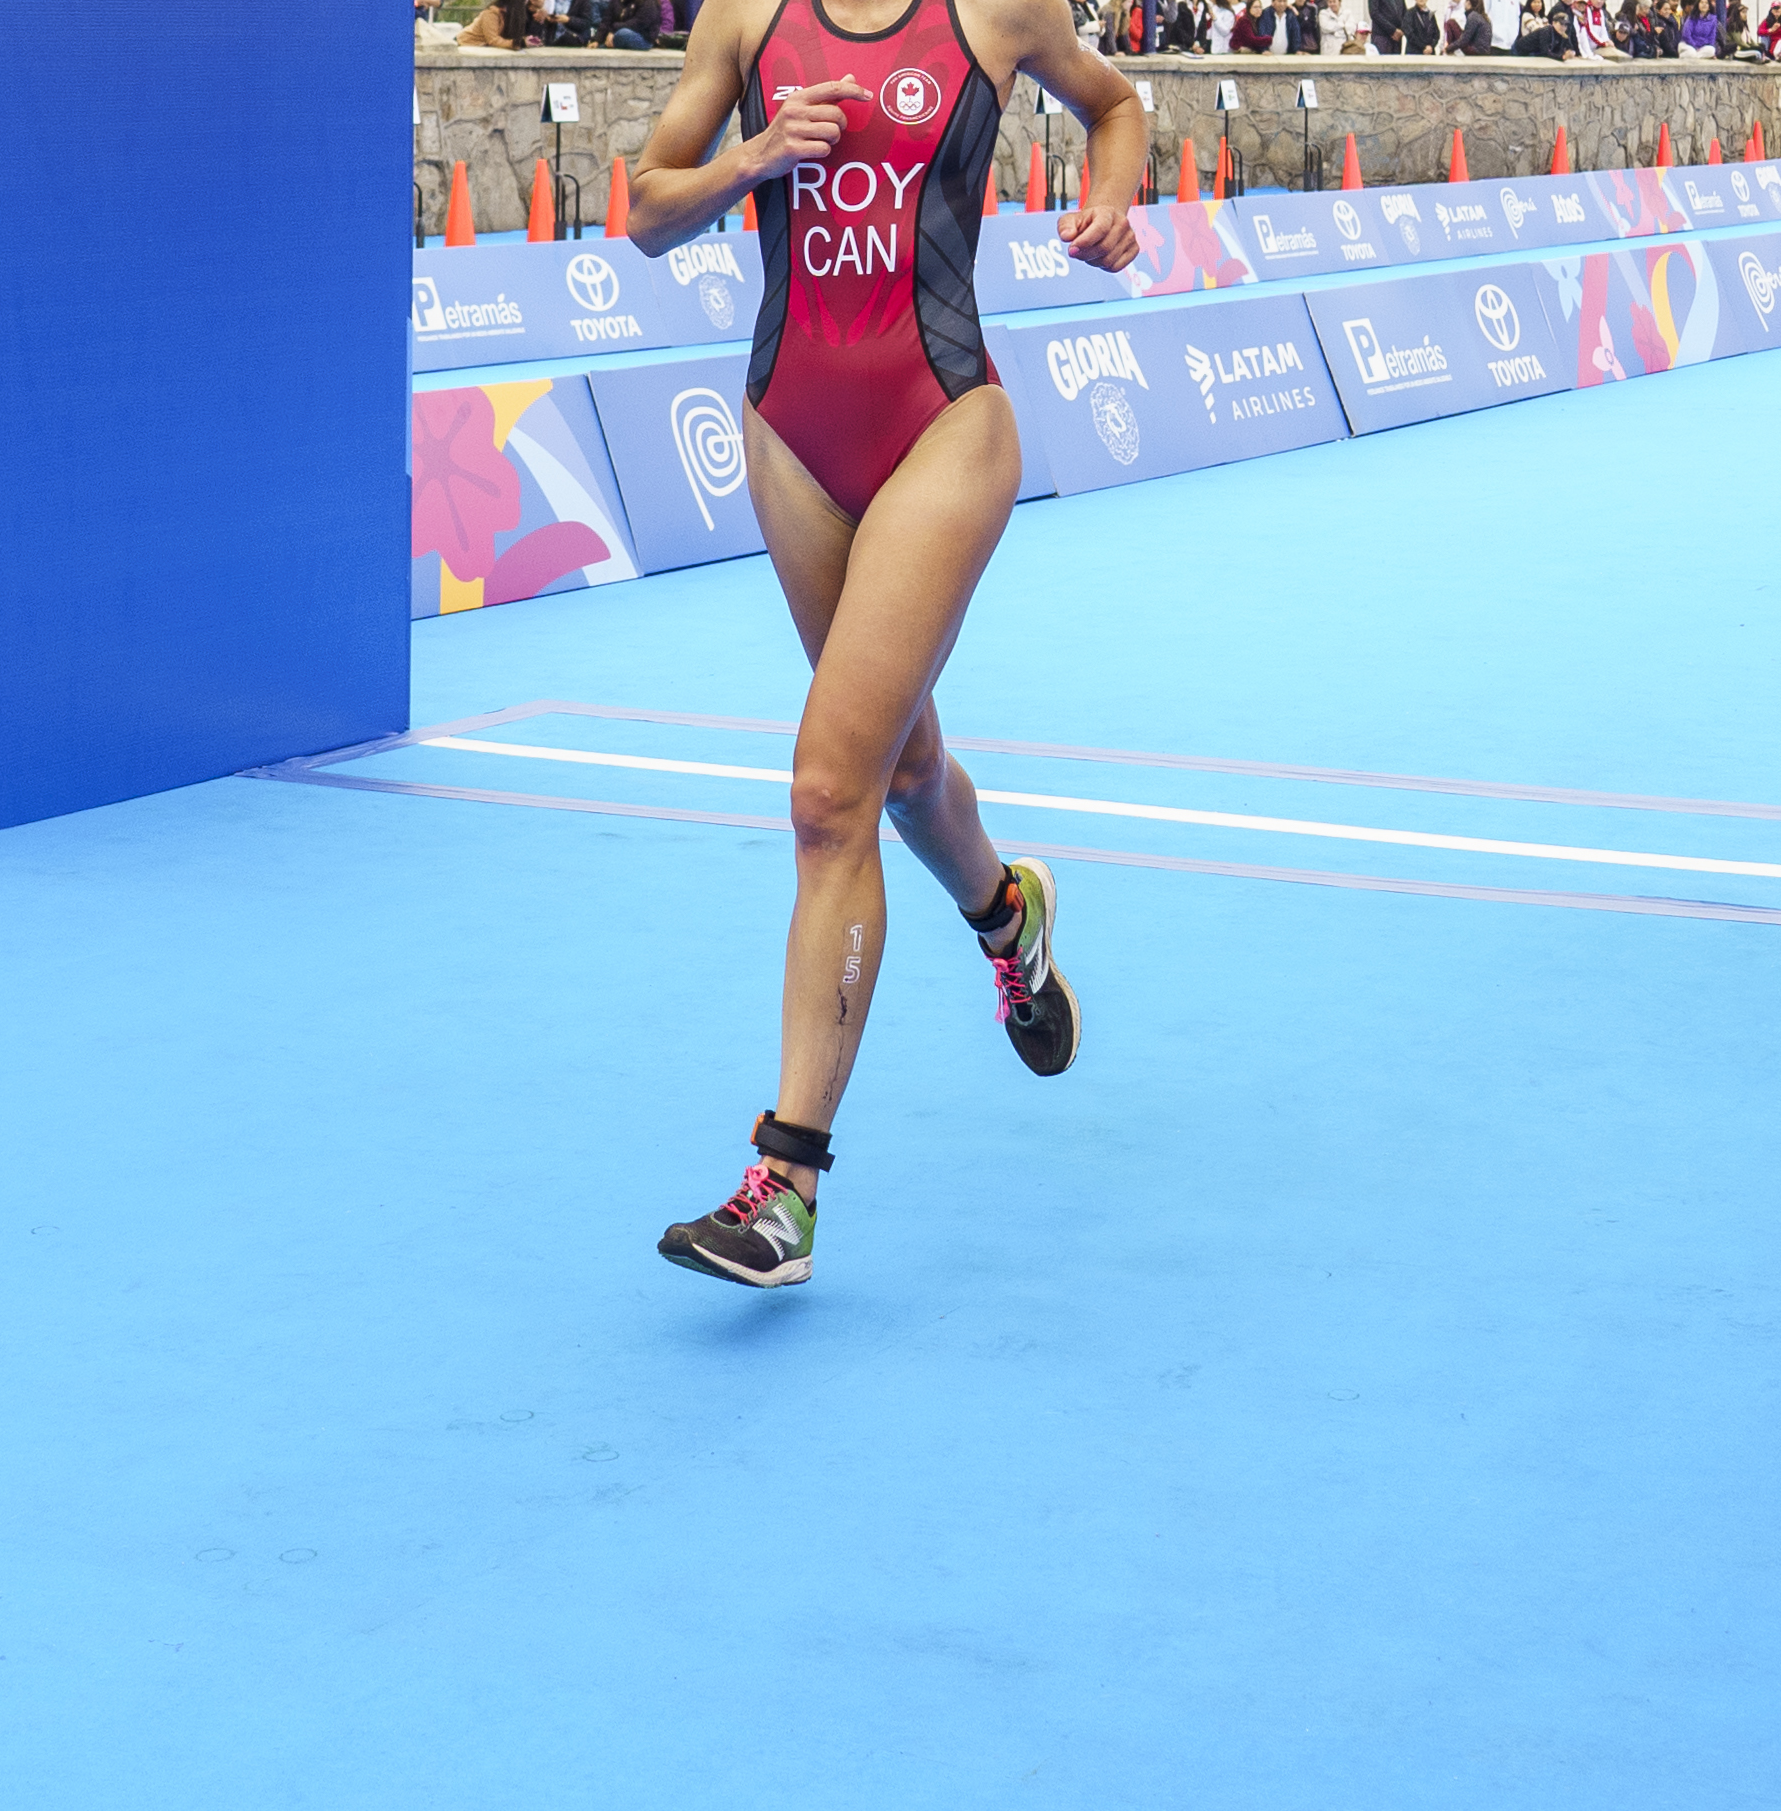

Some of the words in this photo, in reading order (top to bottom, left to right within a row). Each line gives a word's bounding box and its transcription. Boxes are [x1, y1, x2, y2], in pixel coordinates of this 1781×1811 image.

[792, 161, 926, 212] ROY
[1380, 193, 1422, 225] GLORIA
[1448, 204, 1487, 223] LATAM
[803, 225, 898, 278] CAN
[1253, 215, 1317, 253] Petramás
[1341, 242, 1376, 261] TOYOTA
[1457, 226, 1493, 241] AIRLINES
[668, 243, 745, 286] GLORIA
[412, 277, 522, 331] Petramás
[570, 315, 642, 341] TOYOTA
[1047, 330, 1150, 401] GLORIA
[1214, 342, 1304, 384] LATAM
[1342, 318, 1448, 384] Petramás
[1487, 355, 1546, 387] TOYOTA
[1231, 386, 1316, 421] AIRLINES
